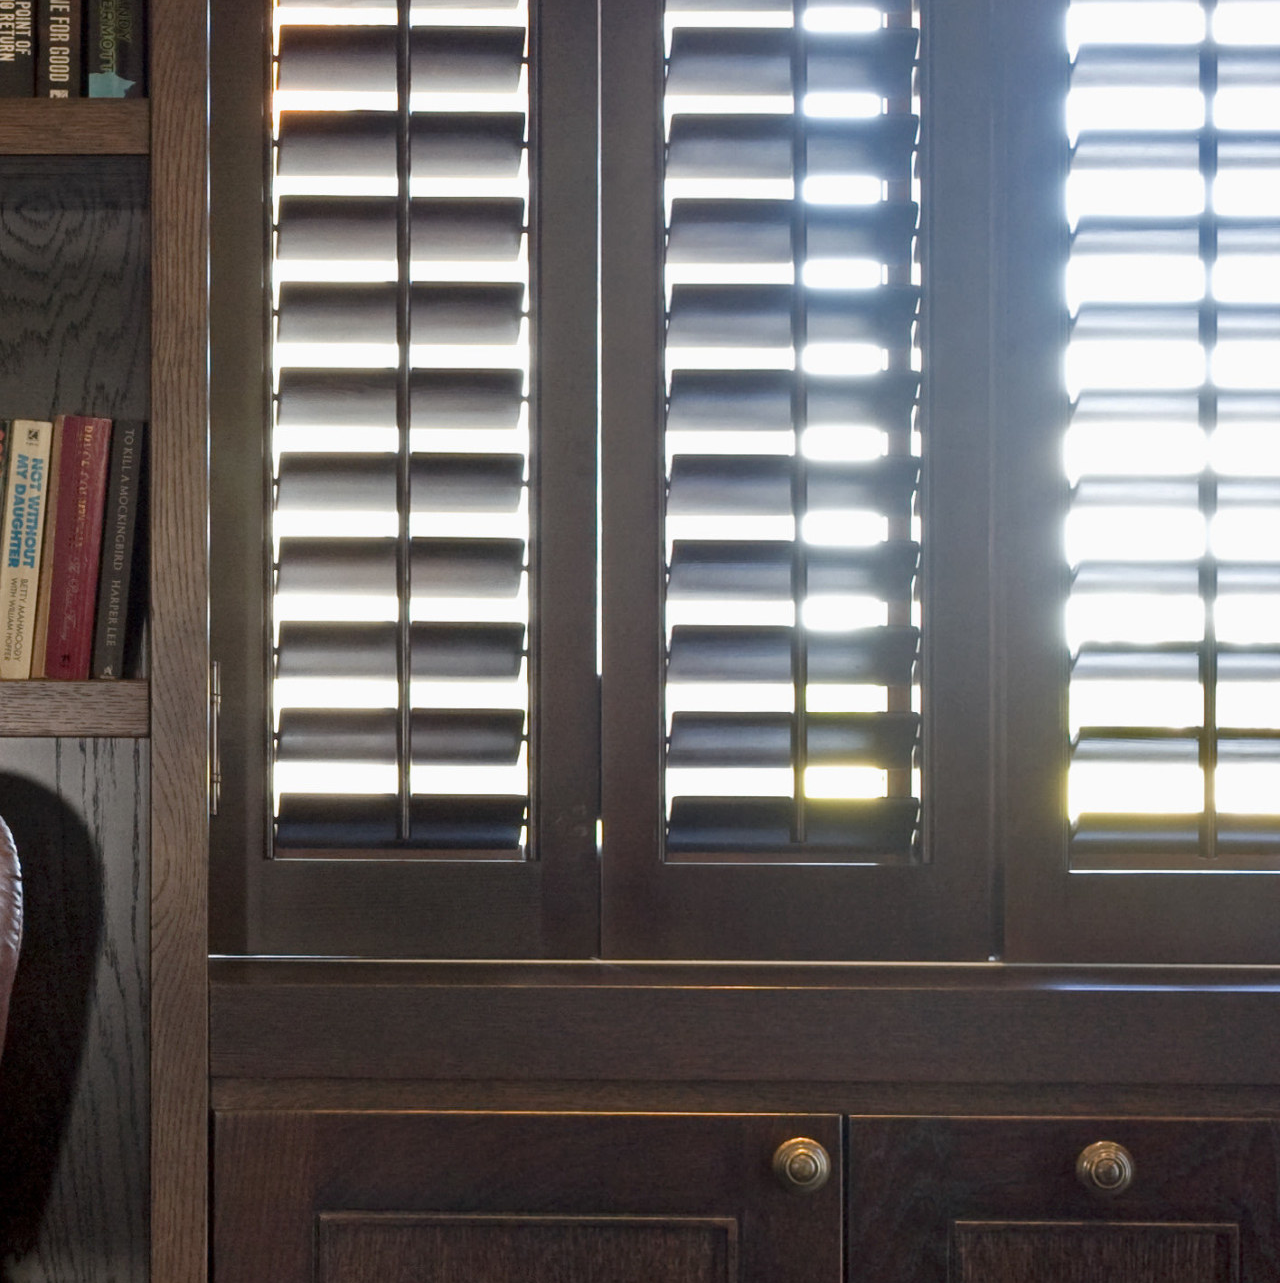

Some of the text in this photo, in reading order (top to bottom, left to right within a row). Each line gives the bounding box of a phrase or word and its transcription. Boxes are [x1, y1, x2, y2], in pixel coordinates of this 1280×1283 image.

[49, 45, 70, 83] GOOD
[50, 17, 70, 42] FOR
[8, 454, 29, 568] MY DAUGHTER
[23, 457, 43, 569] NOT WITHOUT
